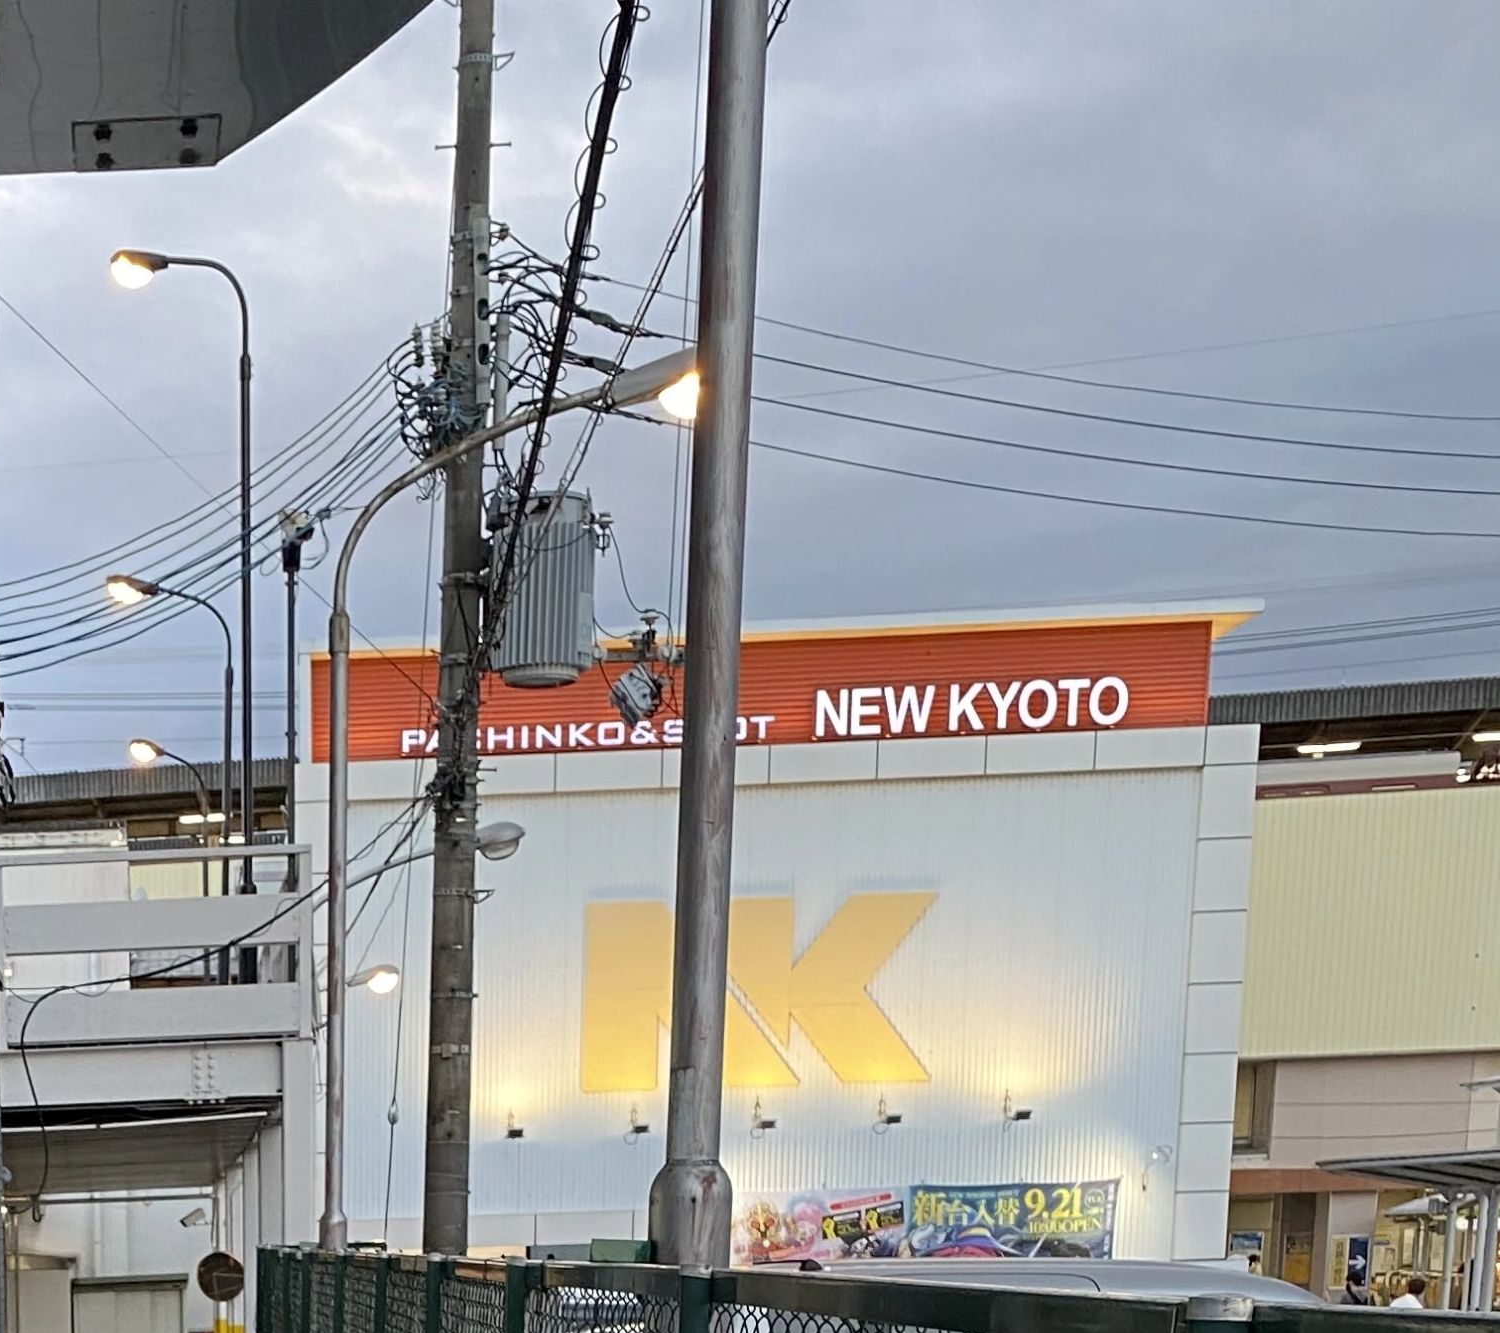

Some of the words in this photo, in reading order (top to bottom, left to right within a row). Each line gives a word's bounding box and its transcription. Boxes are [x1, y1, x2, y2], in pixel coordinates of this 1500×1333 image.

[815, 685, 936, 736] NEW
[949, 676, 1130, 731] KYOTO
[402, 715, 776, 753] PAHINKO&ST
[913, 1189, 1021, 1227] 新台入替
[1025, 1187, 1083, 1218] 9.21
